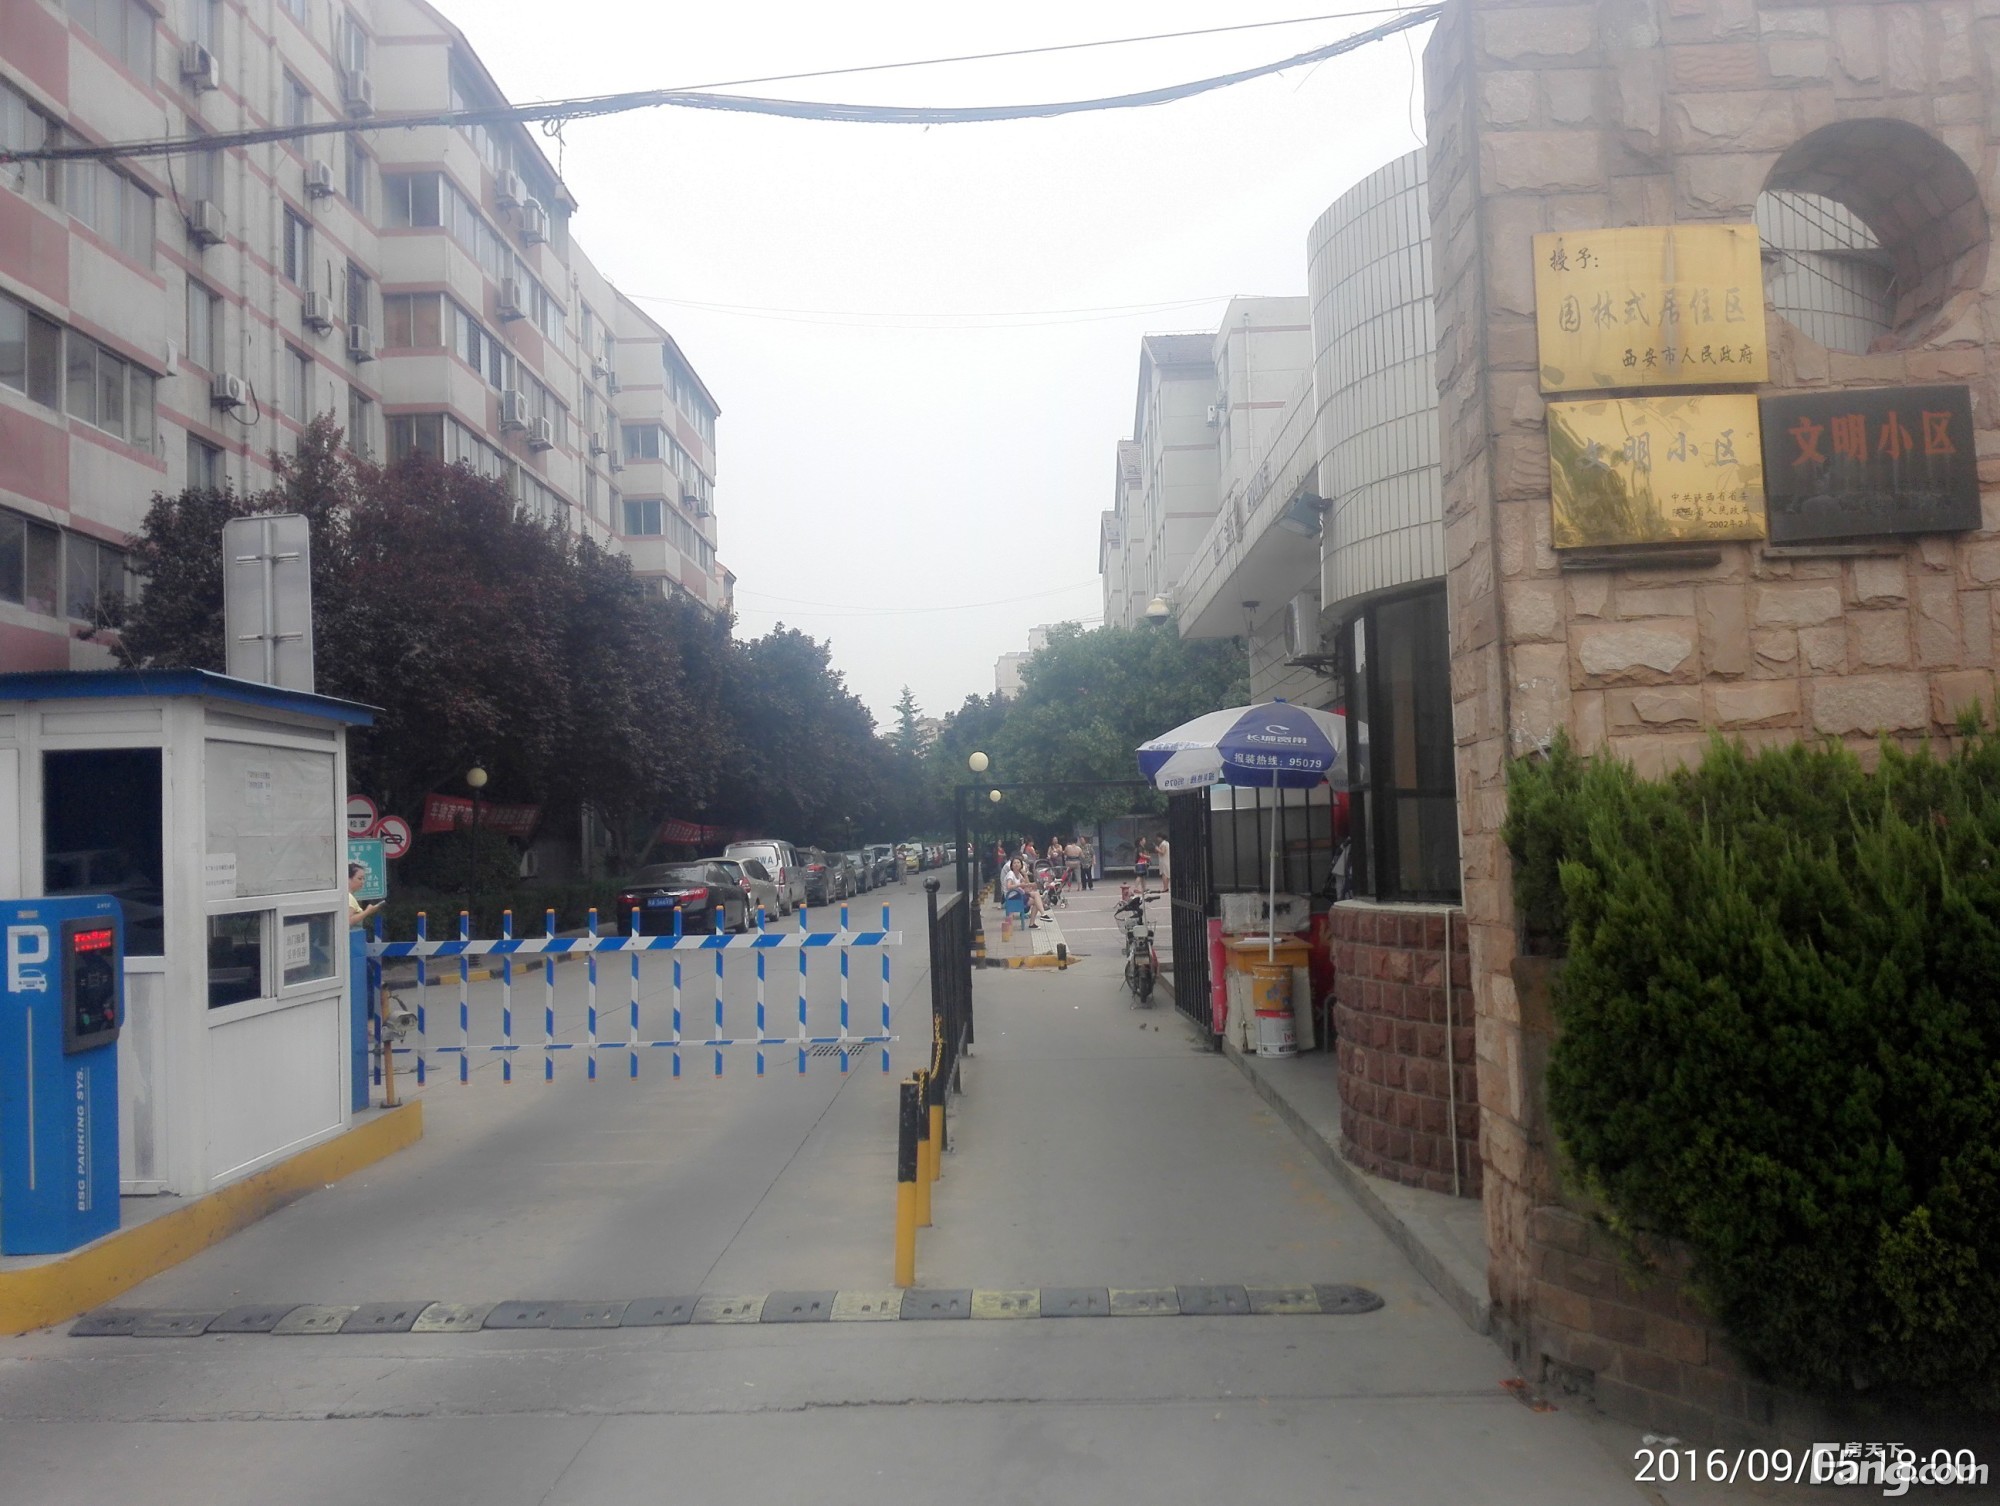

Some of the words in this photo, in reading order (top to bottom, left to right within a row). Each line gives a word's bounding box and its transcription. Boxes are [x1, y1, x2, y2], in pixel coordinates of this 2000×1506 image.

[1559, 287, 1746, 333] 园林式居住区
[1622, 344, 1753, 368] 西安市人民政府
[1575, 428, 1739, 473] 文明小区
[1788, 410, 1957, 466] 文明小区
[77, 1105, 86, 1175] PARKING
[77, 1180, 86, 1211] BSG
